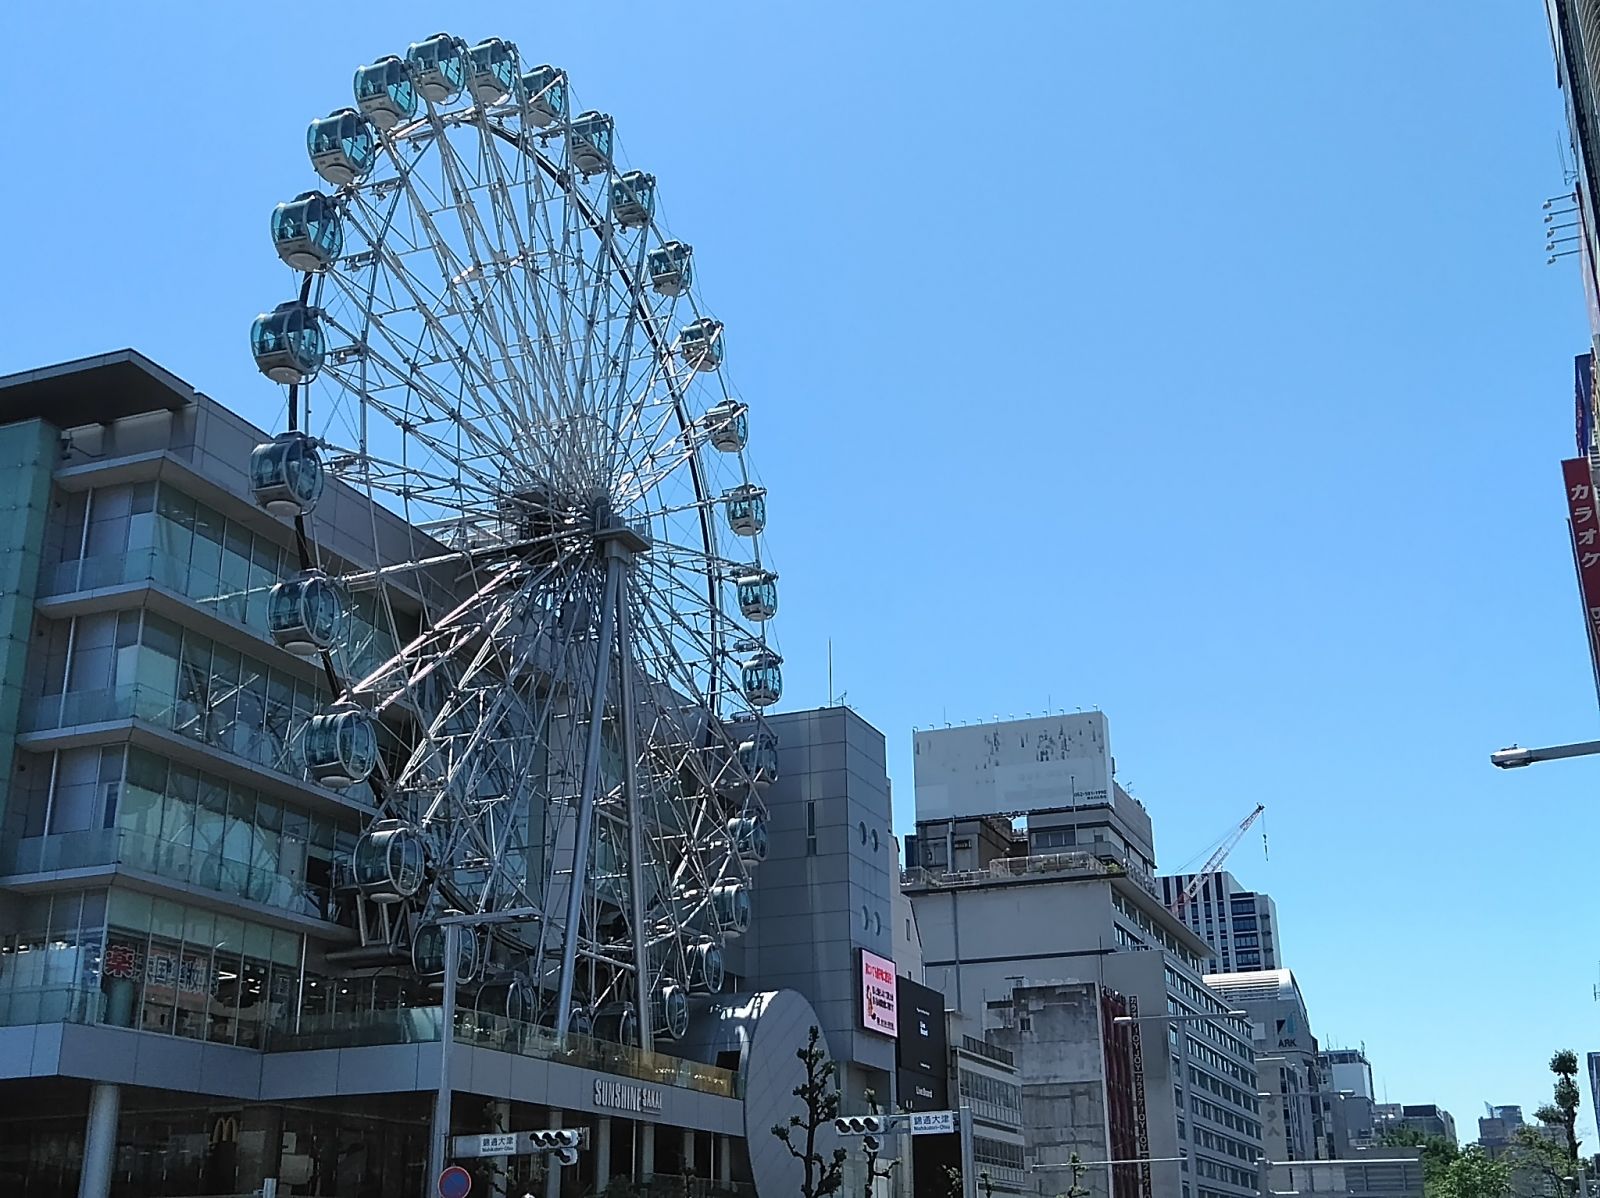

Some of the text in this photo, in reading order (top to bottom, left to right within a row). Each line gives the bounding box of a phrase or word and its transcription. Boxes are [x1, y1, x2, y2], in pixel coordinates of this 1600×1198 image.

[1571, 484, 1600, 568] カラオケ
[1278, 1038, 1297, 1048] ARK
[595, 1079, 641, 1111] SUNSHINE
[913, 1114, 949, 1125] 錦通大津
